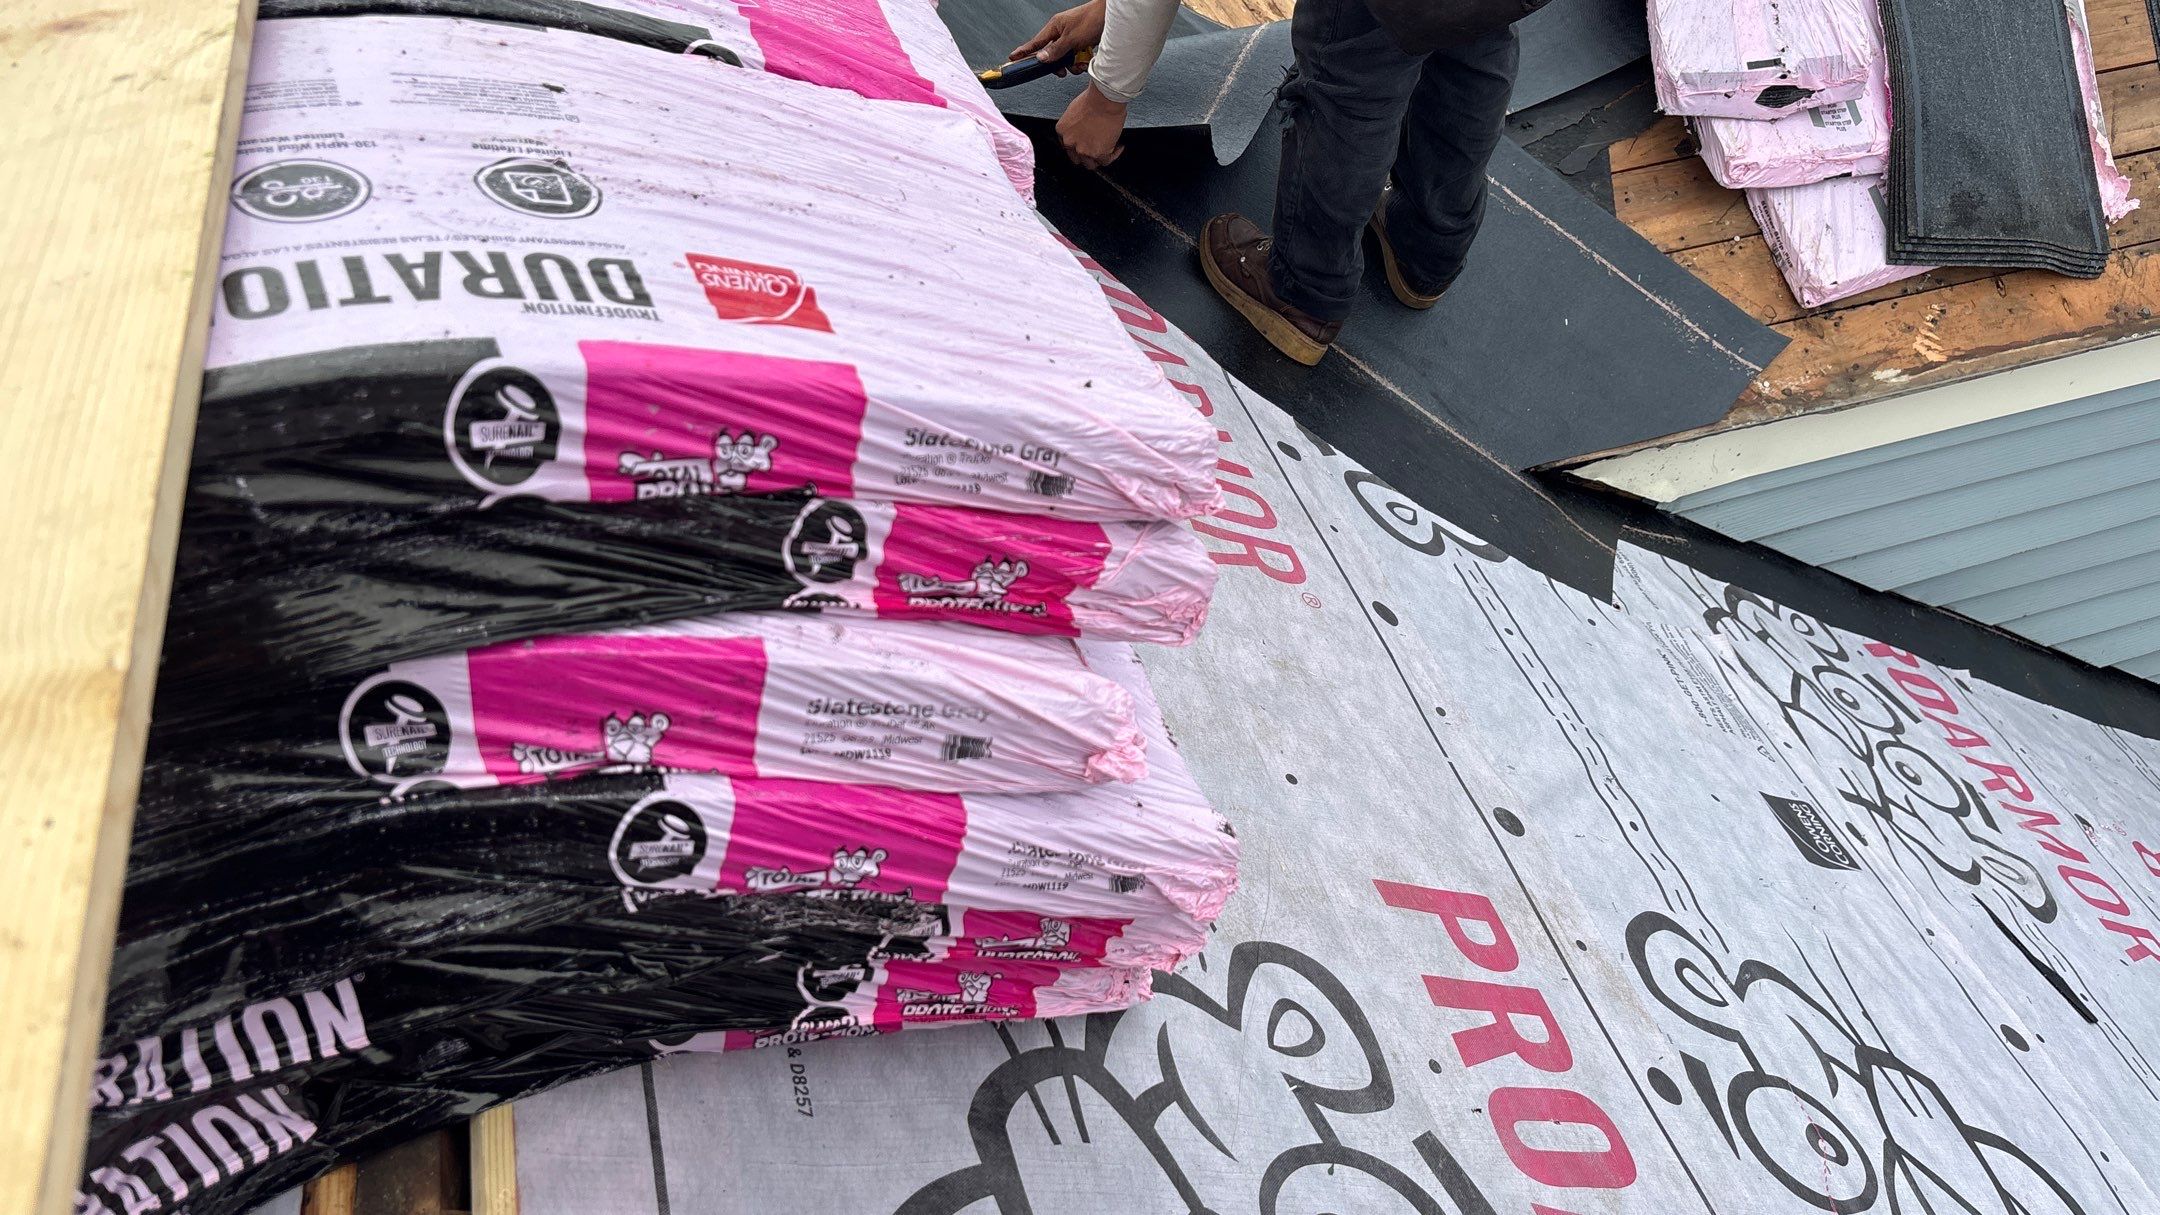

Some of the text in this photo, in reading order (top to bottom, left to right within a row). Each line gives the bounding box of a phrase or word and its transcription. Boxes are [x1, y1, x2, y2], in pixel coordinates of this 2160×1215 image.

[211, 251, 655, 326] DURATIO
[701, 272, 788, 297] OWENS
[521, 302, 663, 323] TRUDEFINITION
[1020, 443, 1067, 468] Gray
[941, 702, 991, 723] Gray
[1788, 802, 1830, 853] OWENS
[1799, 804, 1850, 865] CORNING
[1372, 879, 1637, 1215] PRO
[787, 1048, 814, 1118] & D8257
